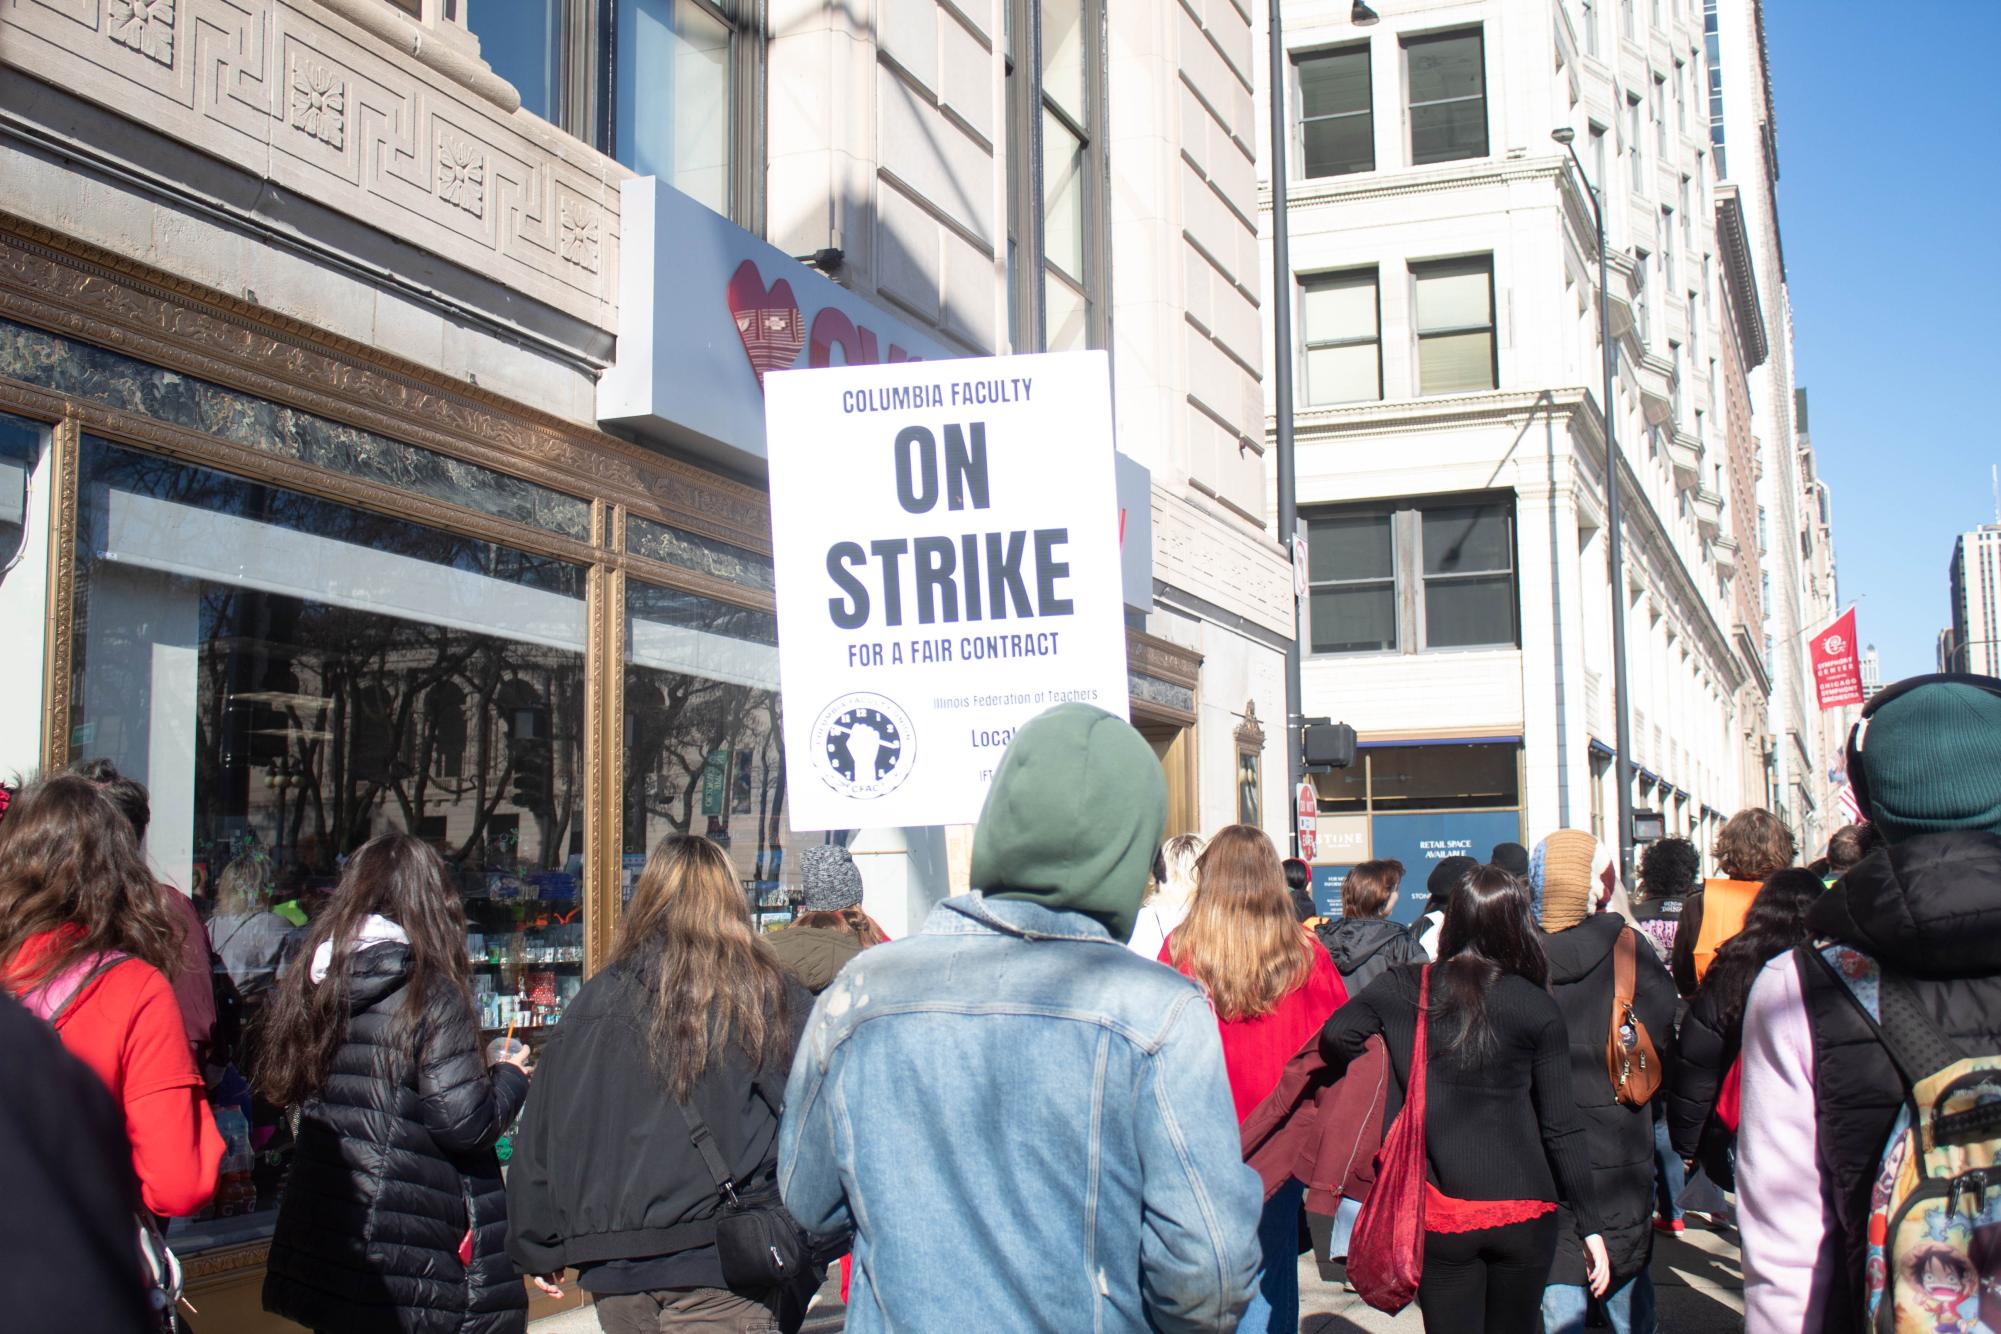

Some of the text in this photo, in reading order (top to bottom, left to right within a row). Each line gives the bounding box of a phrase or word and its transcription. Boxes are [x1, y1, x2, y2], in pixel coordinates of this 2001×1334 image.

[842, 377, 1033, 413] COLUMBIA FACULTY
[893, 421, 991, 515] ON
[825, 527, 1075, 630] STRIKE
[847, 631, 1059, 668] FOR A FAIR CONTRACT
[1817, 663, 1854, 677] CENTER
[1820, 678, 1857, 690] CHICAGO
[934, 688, 1099, 710] Illinois Federation of Teachers
[856, 708, 867, 718] 12
[1420, 840, 1472, 849] RETAIL SPACE
